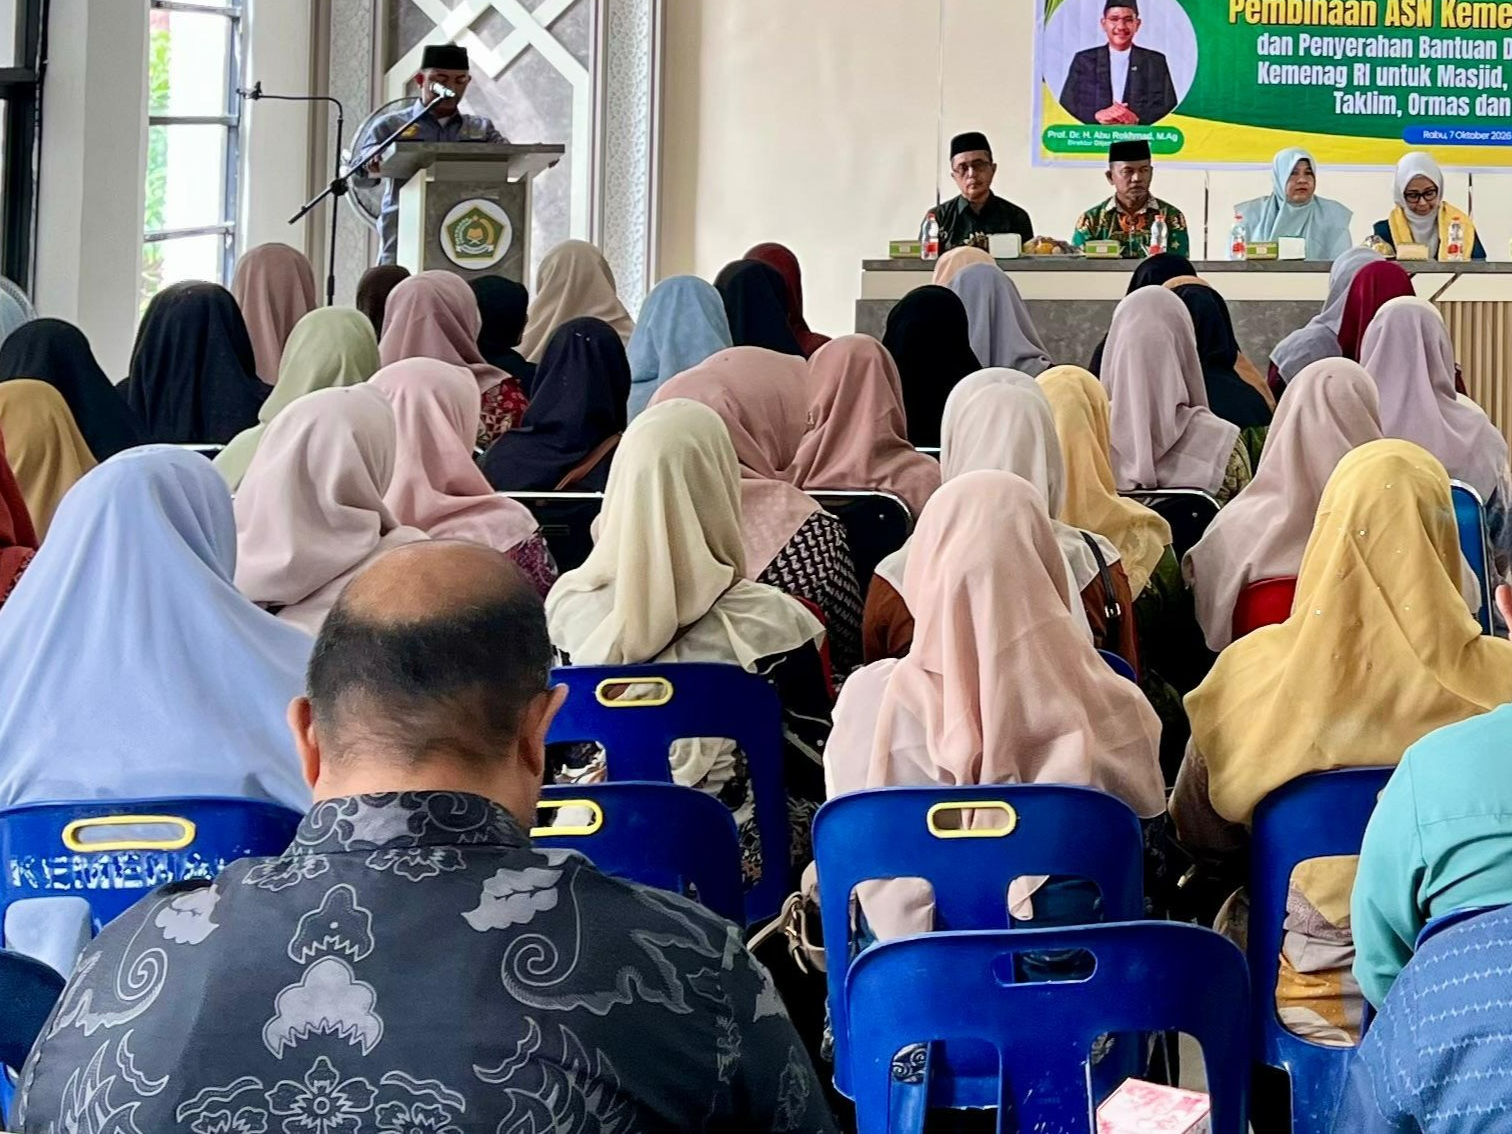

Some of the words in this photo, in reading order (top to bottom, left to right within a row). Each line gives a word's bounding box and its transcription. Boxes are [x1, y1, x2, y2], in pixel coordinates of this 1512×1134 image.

[1257, 32, 1293, 56] dan
[1298, 33, 1413, 59] Penyerahan
[1419, 35, 1497, 60] Bantuan
[1257, 61, 1347, 88] Kemenag
[1353, 63, 1370, 86] RI
[1376, 64, 1432, 87] untuk
[1437, 65, 1508, 91] Masjid,
[1333, 91, 1402, 117] Taklim,
[1408, 92, 1470, 116] Ormas
[1475, 94, 1511, 117] dan
[1047, 130, 1068, 139] Prof.
[1069, 130, 1080, 139] Dr.
[1083, 131, 1092, 139] H.
[1093, 131, 1111, 140] Abu
[1156, 132, 1179, 142] M.Ag
[1423, 130, 1448, 140] Rabu,
[1449, 131, 1454, 139] 7
[1454, 130, 1490, 140] Oktober
